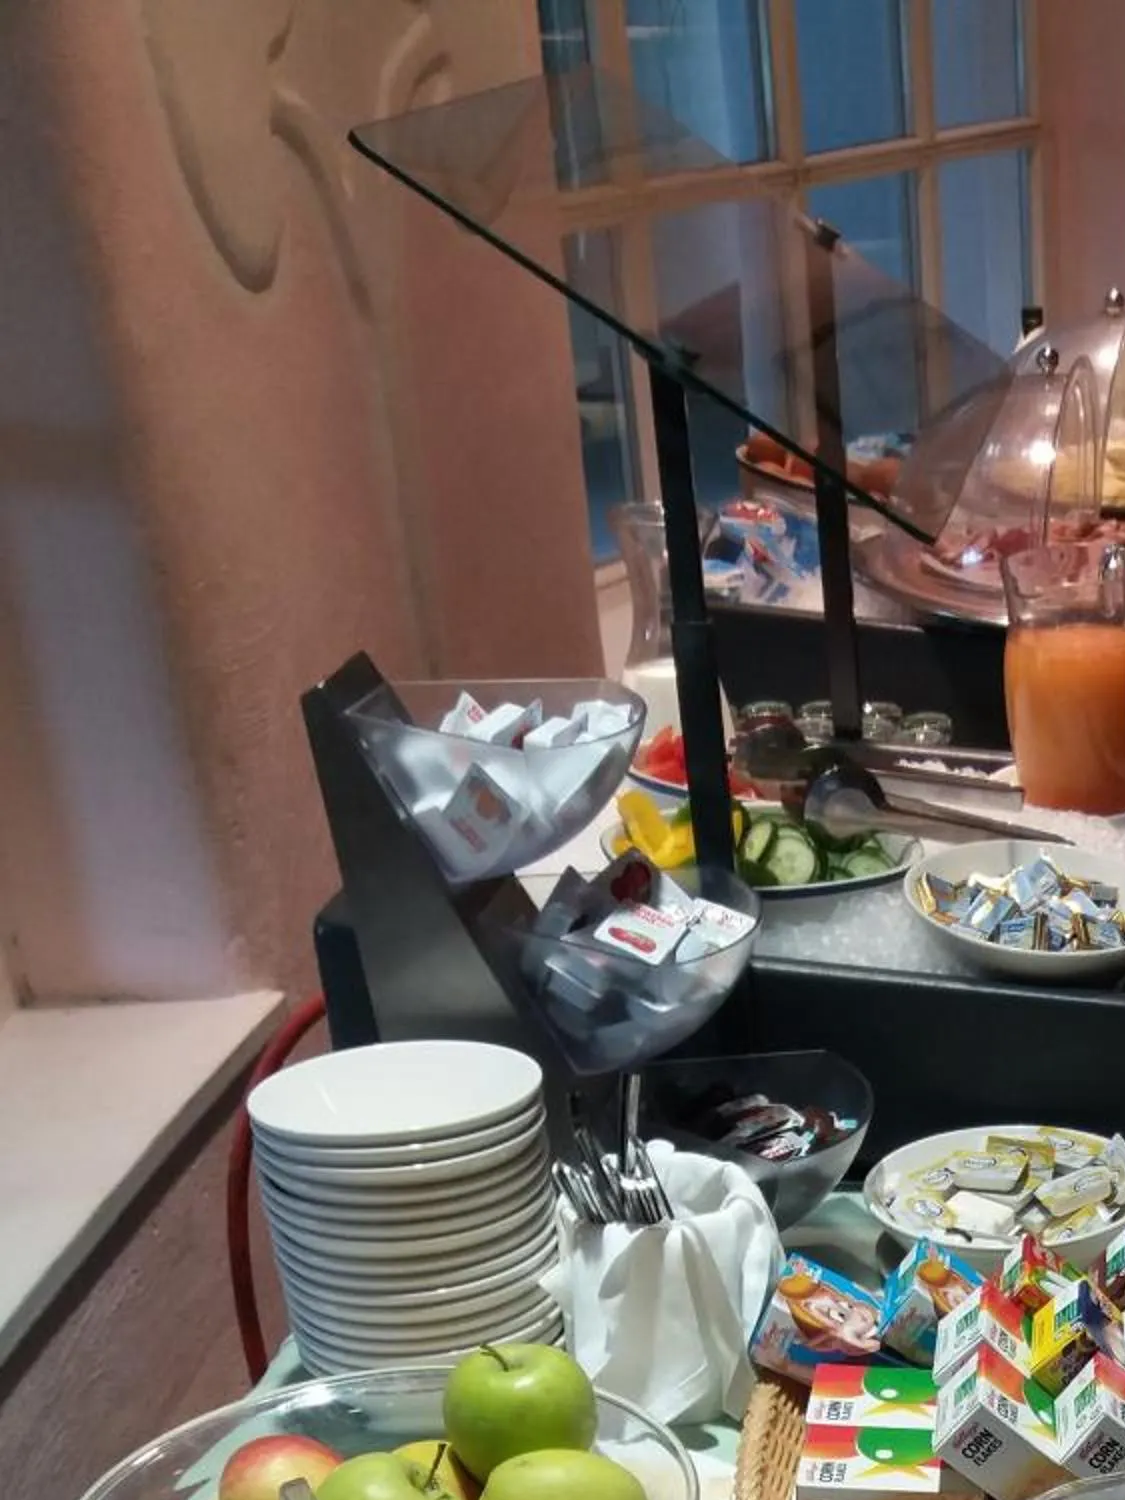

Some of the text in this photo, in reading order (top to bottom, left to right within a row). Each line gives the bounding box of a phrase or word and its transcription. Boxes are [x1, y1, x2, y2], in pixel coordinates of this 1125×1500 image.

[961, 1428, 994, 1459] CORN
[973, 1439, 1003, 1467] FLAKES
[1088, 1437, 1121, 1469] CORN
